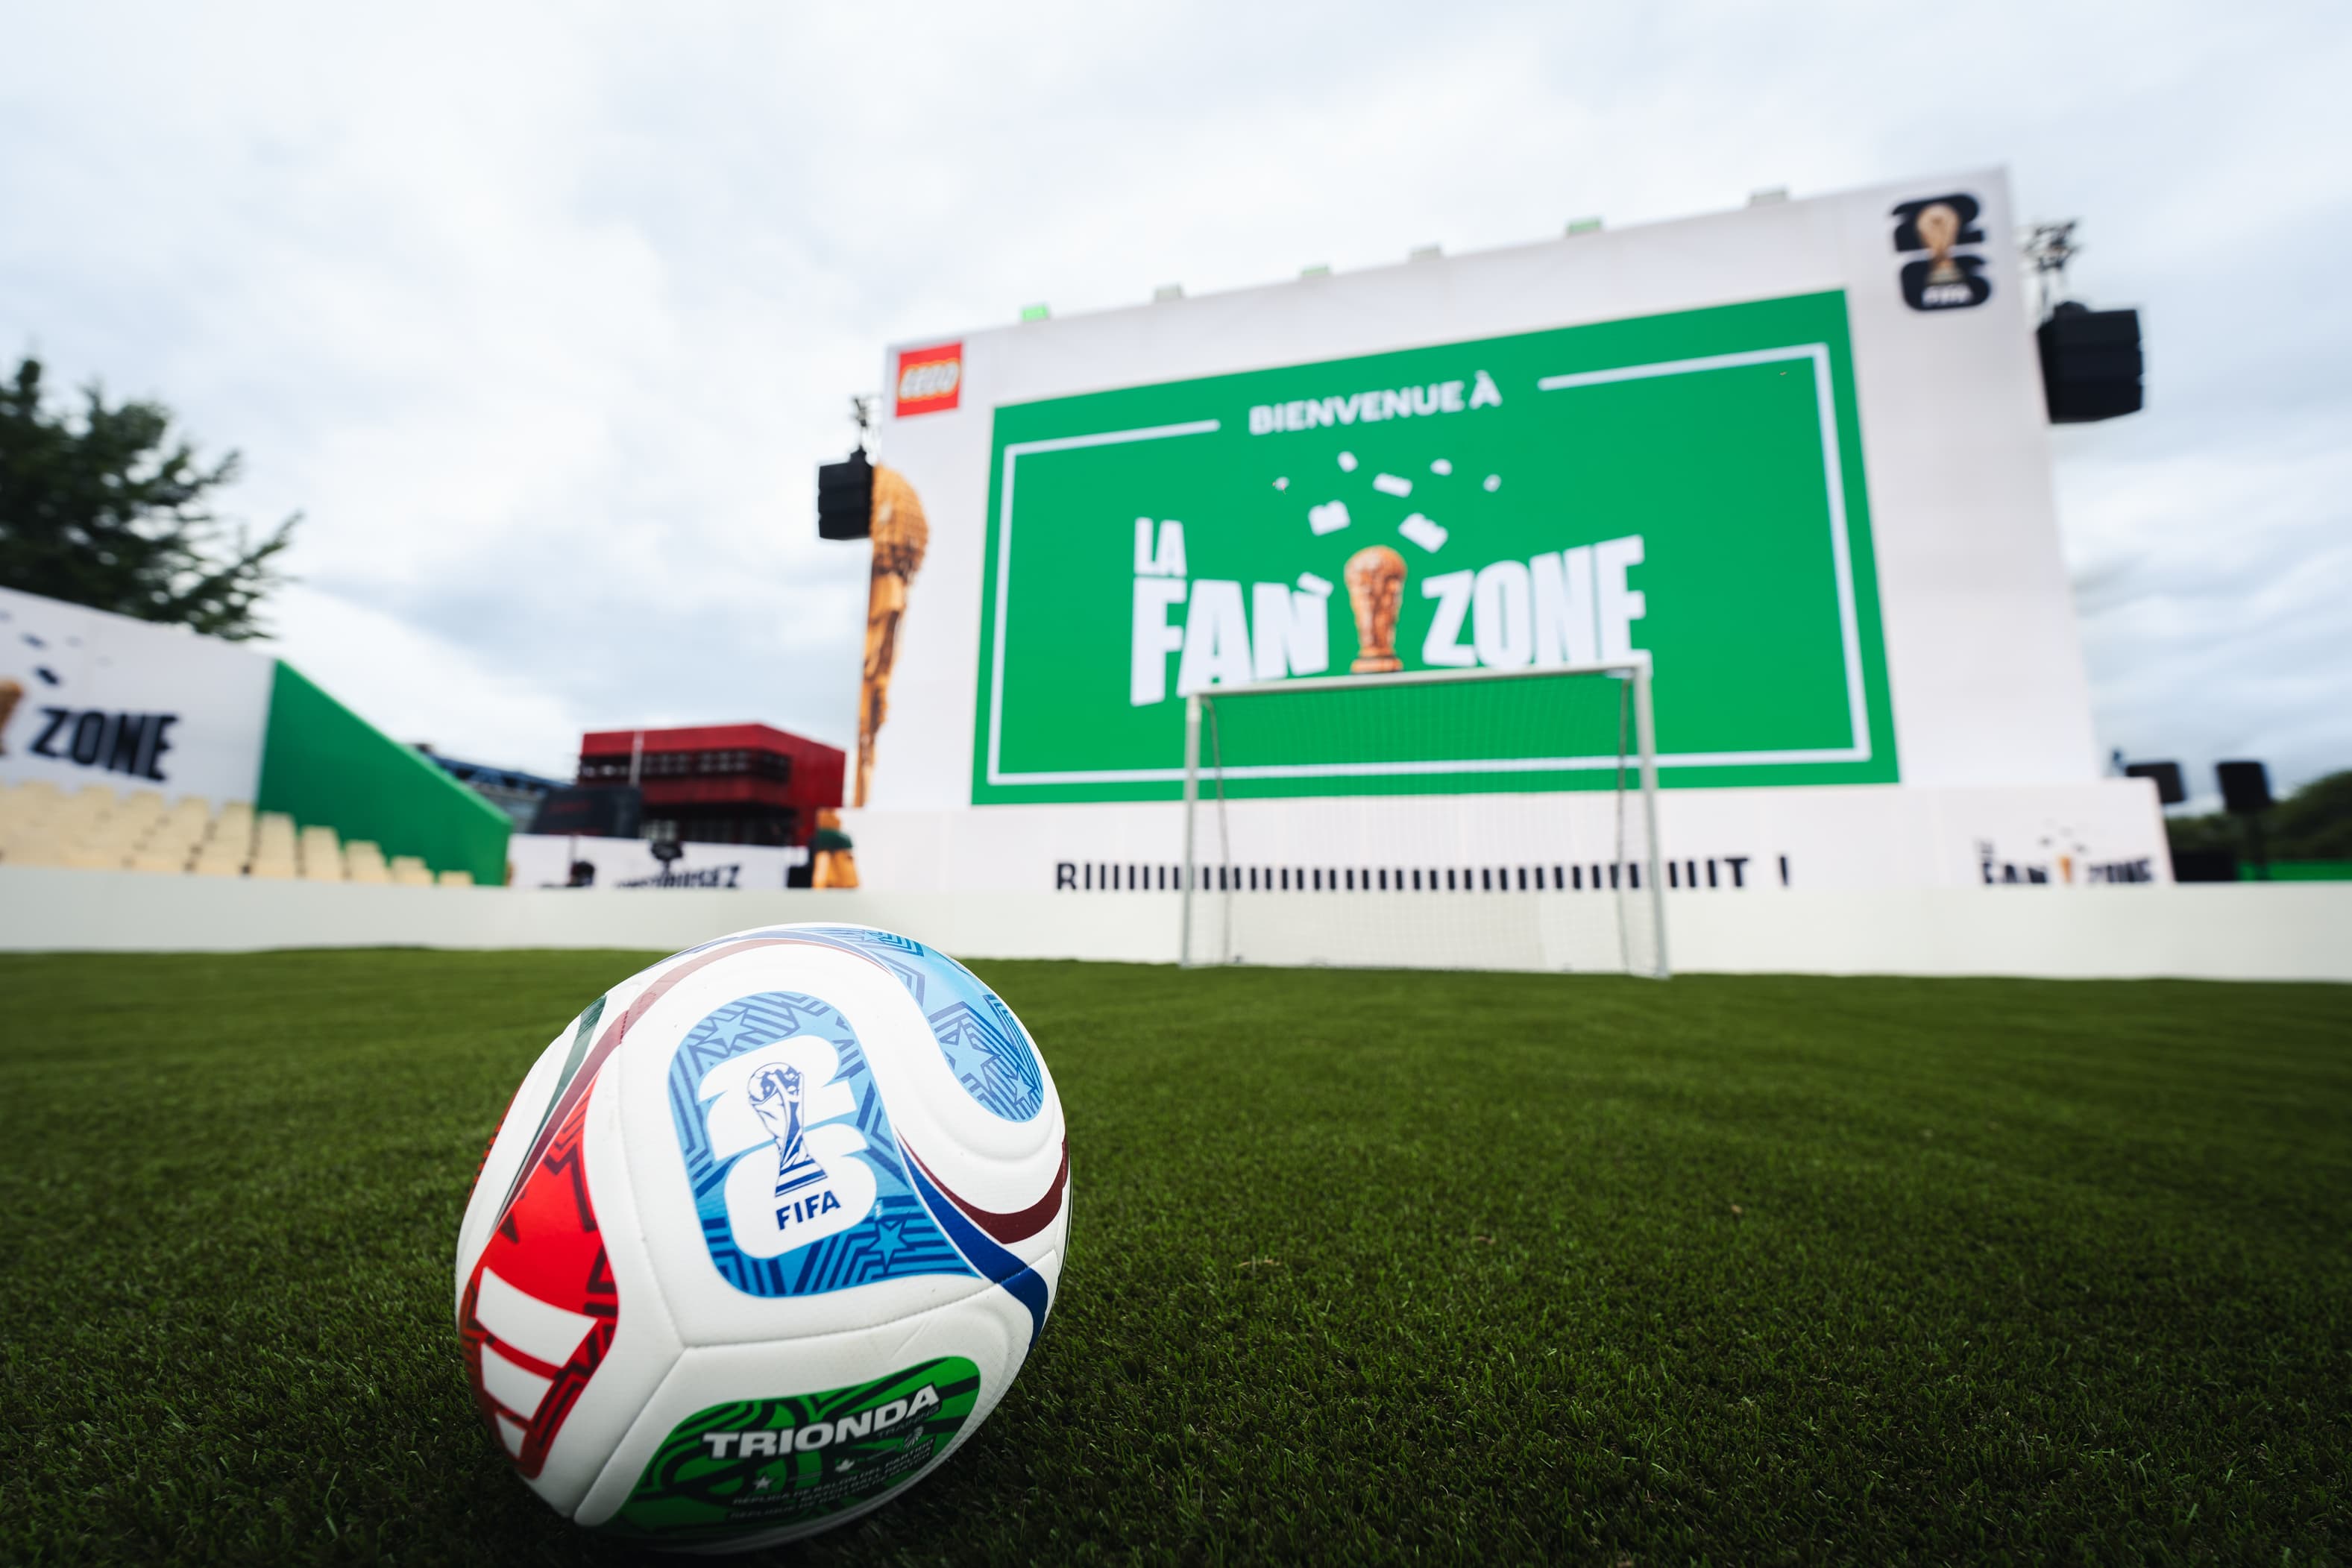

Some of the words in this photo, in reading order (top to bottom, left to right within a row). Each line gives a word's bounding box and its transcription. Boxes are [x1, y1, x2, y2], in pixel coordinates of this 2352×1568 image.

[899, 360, 961, 400] LEGO
[1249, 380, 1465, 435] BIENVENUE
[1470, 370, 1503, 409] À
[1133, 516, 1187, 577] LA
[1131, 576, 1330, 707] FAN
[1422, 535, 1647, 670] ZONE
[31, 707, 179, 781] ZONE
[776, 1189, 841, 1230] FIFA
[702, 1382, 940, 1460] TRIONDA
[877, 1405, 940, 1439] TRAINING
